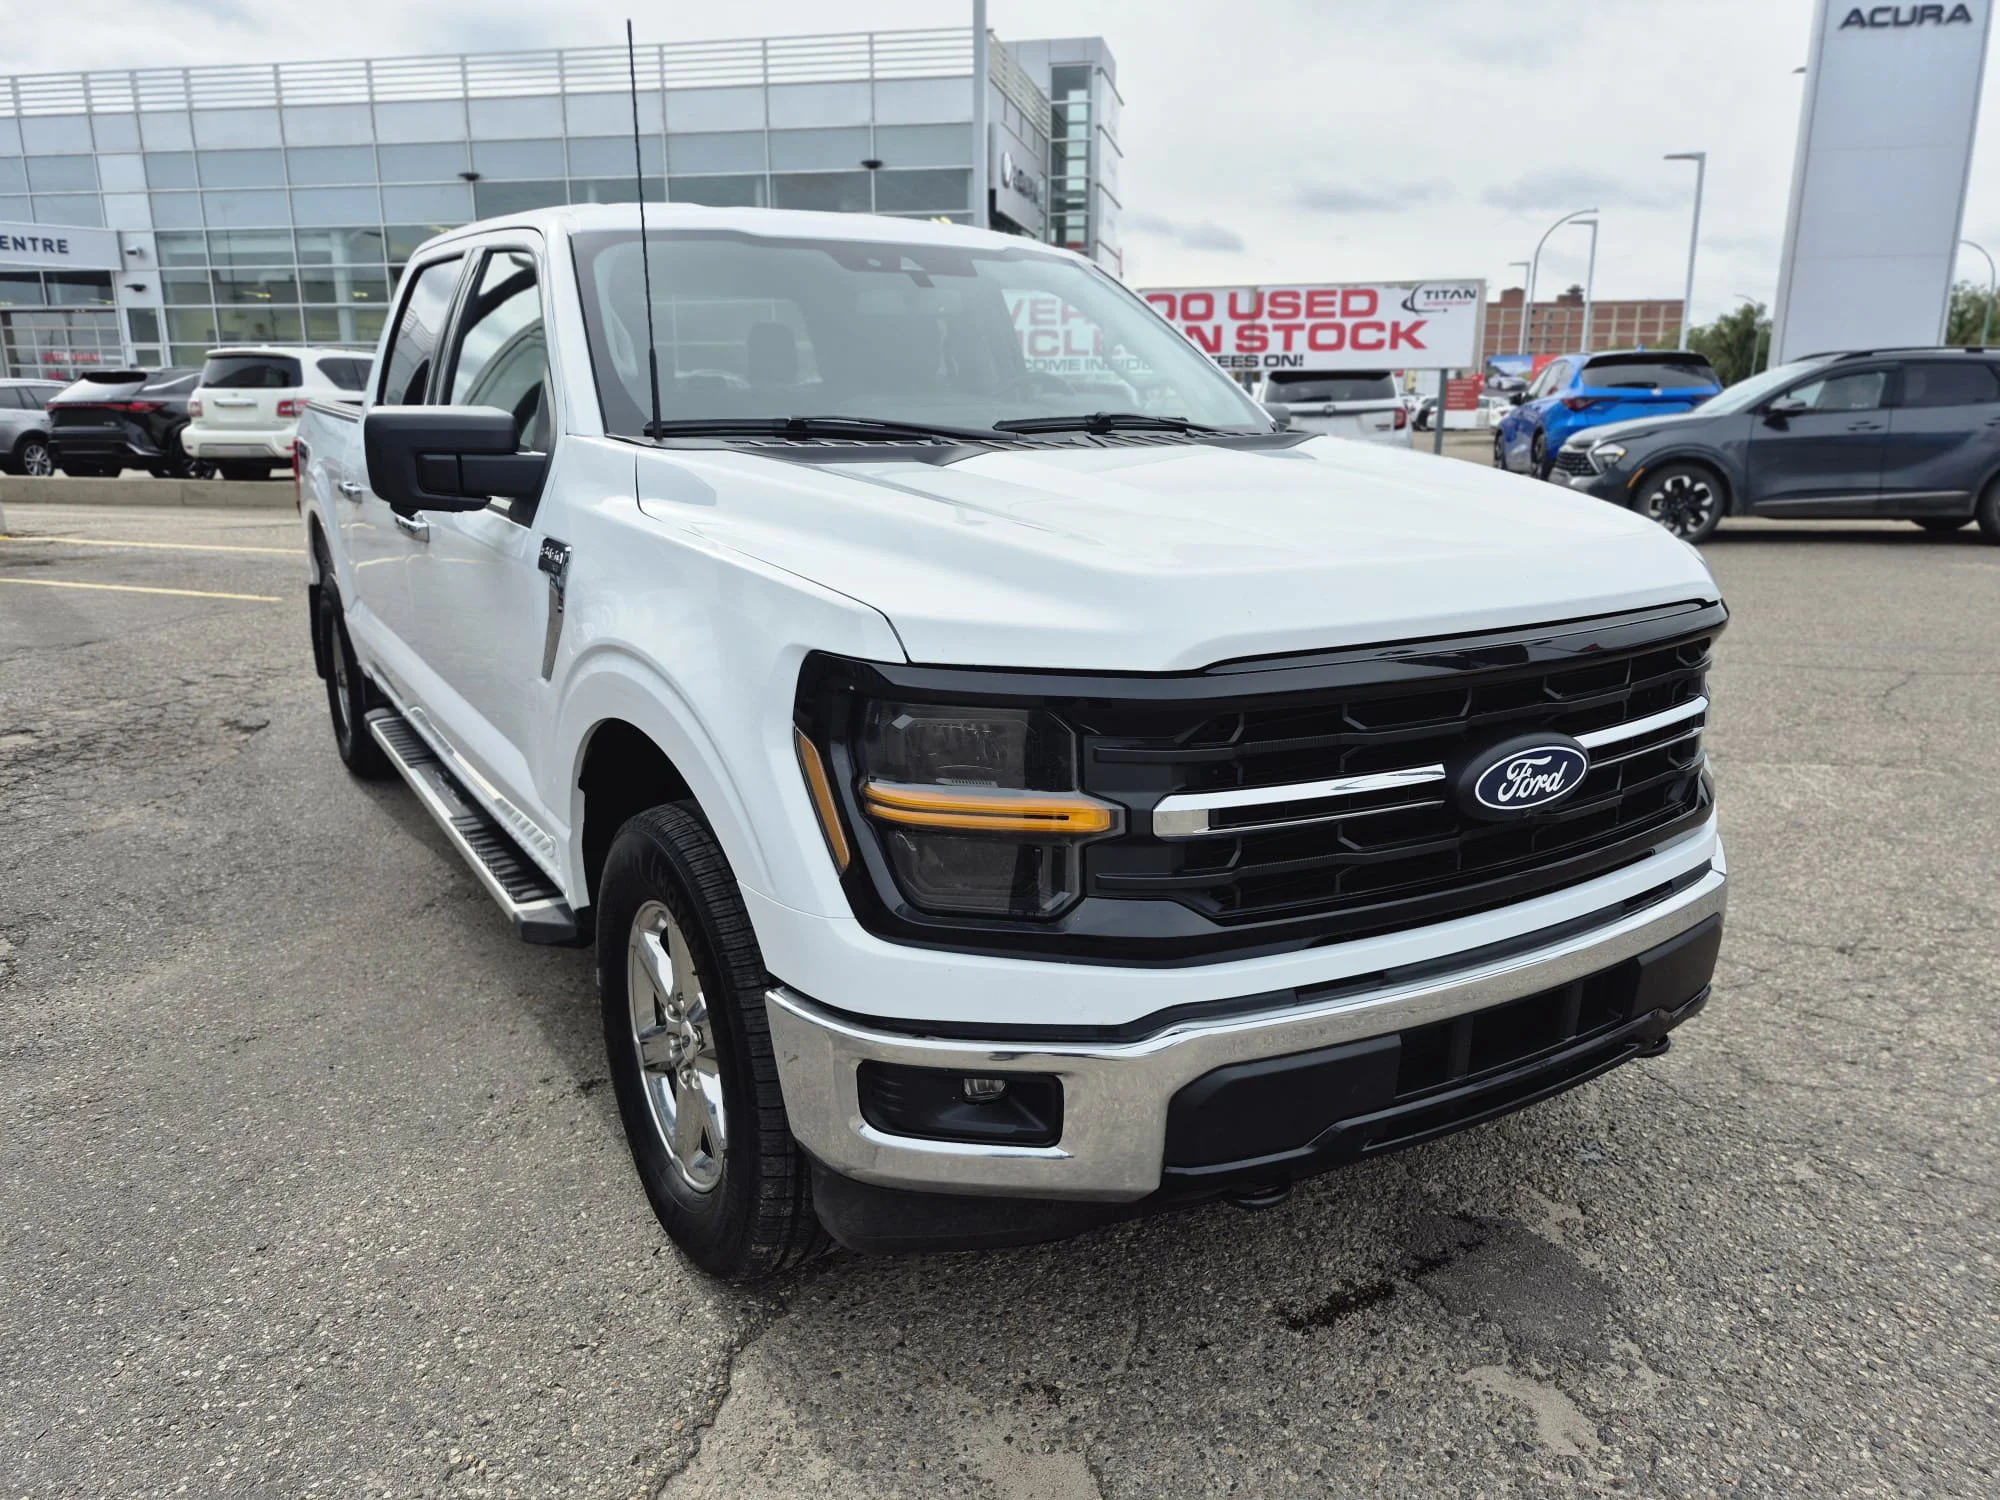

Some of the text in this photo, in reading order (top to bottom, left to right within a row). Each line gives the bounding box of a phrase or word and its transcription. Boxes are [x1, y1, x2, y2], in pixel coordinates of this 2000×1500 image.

[1838, 3, 1972, 30] ACURA
[1227, 288, 1379, 321] USED
[1424, 289, 1477, 300] TITAN
[1235, 320, 1428, 353] STOCK
[1264, 354, 1304, 367] ON!
[1497, 755, 1568, 802] Ford
